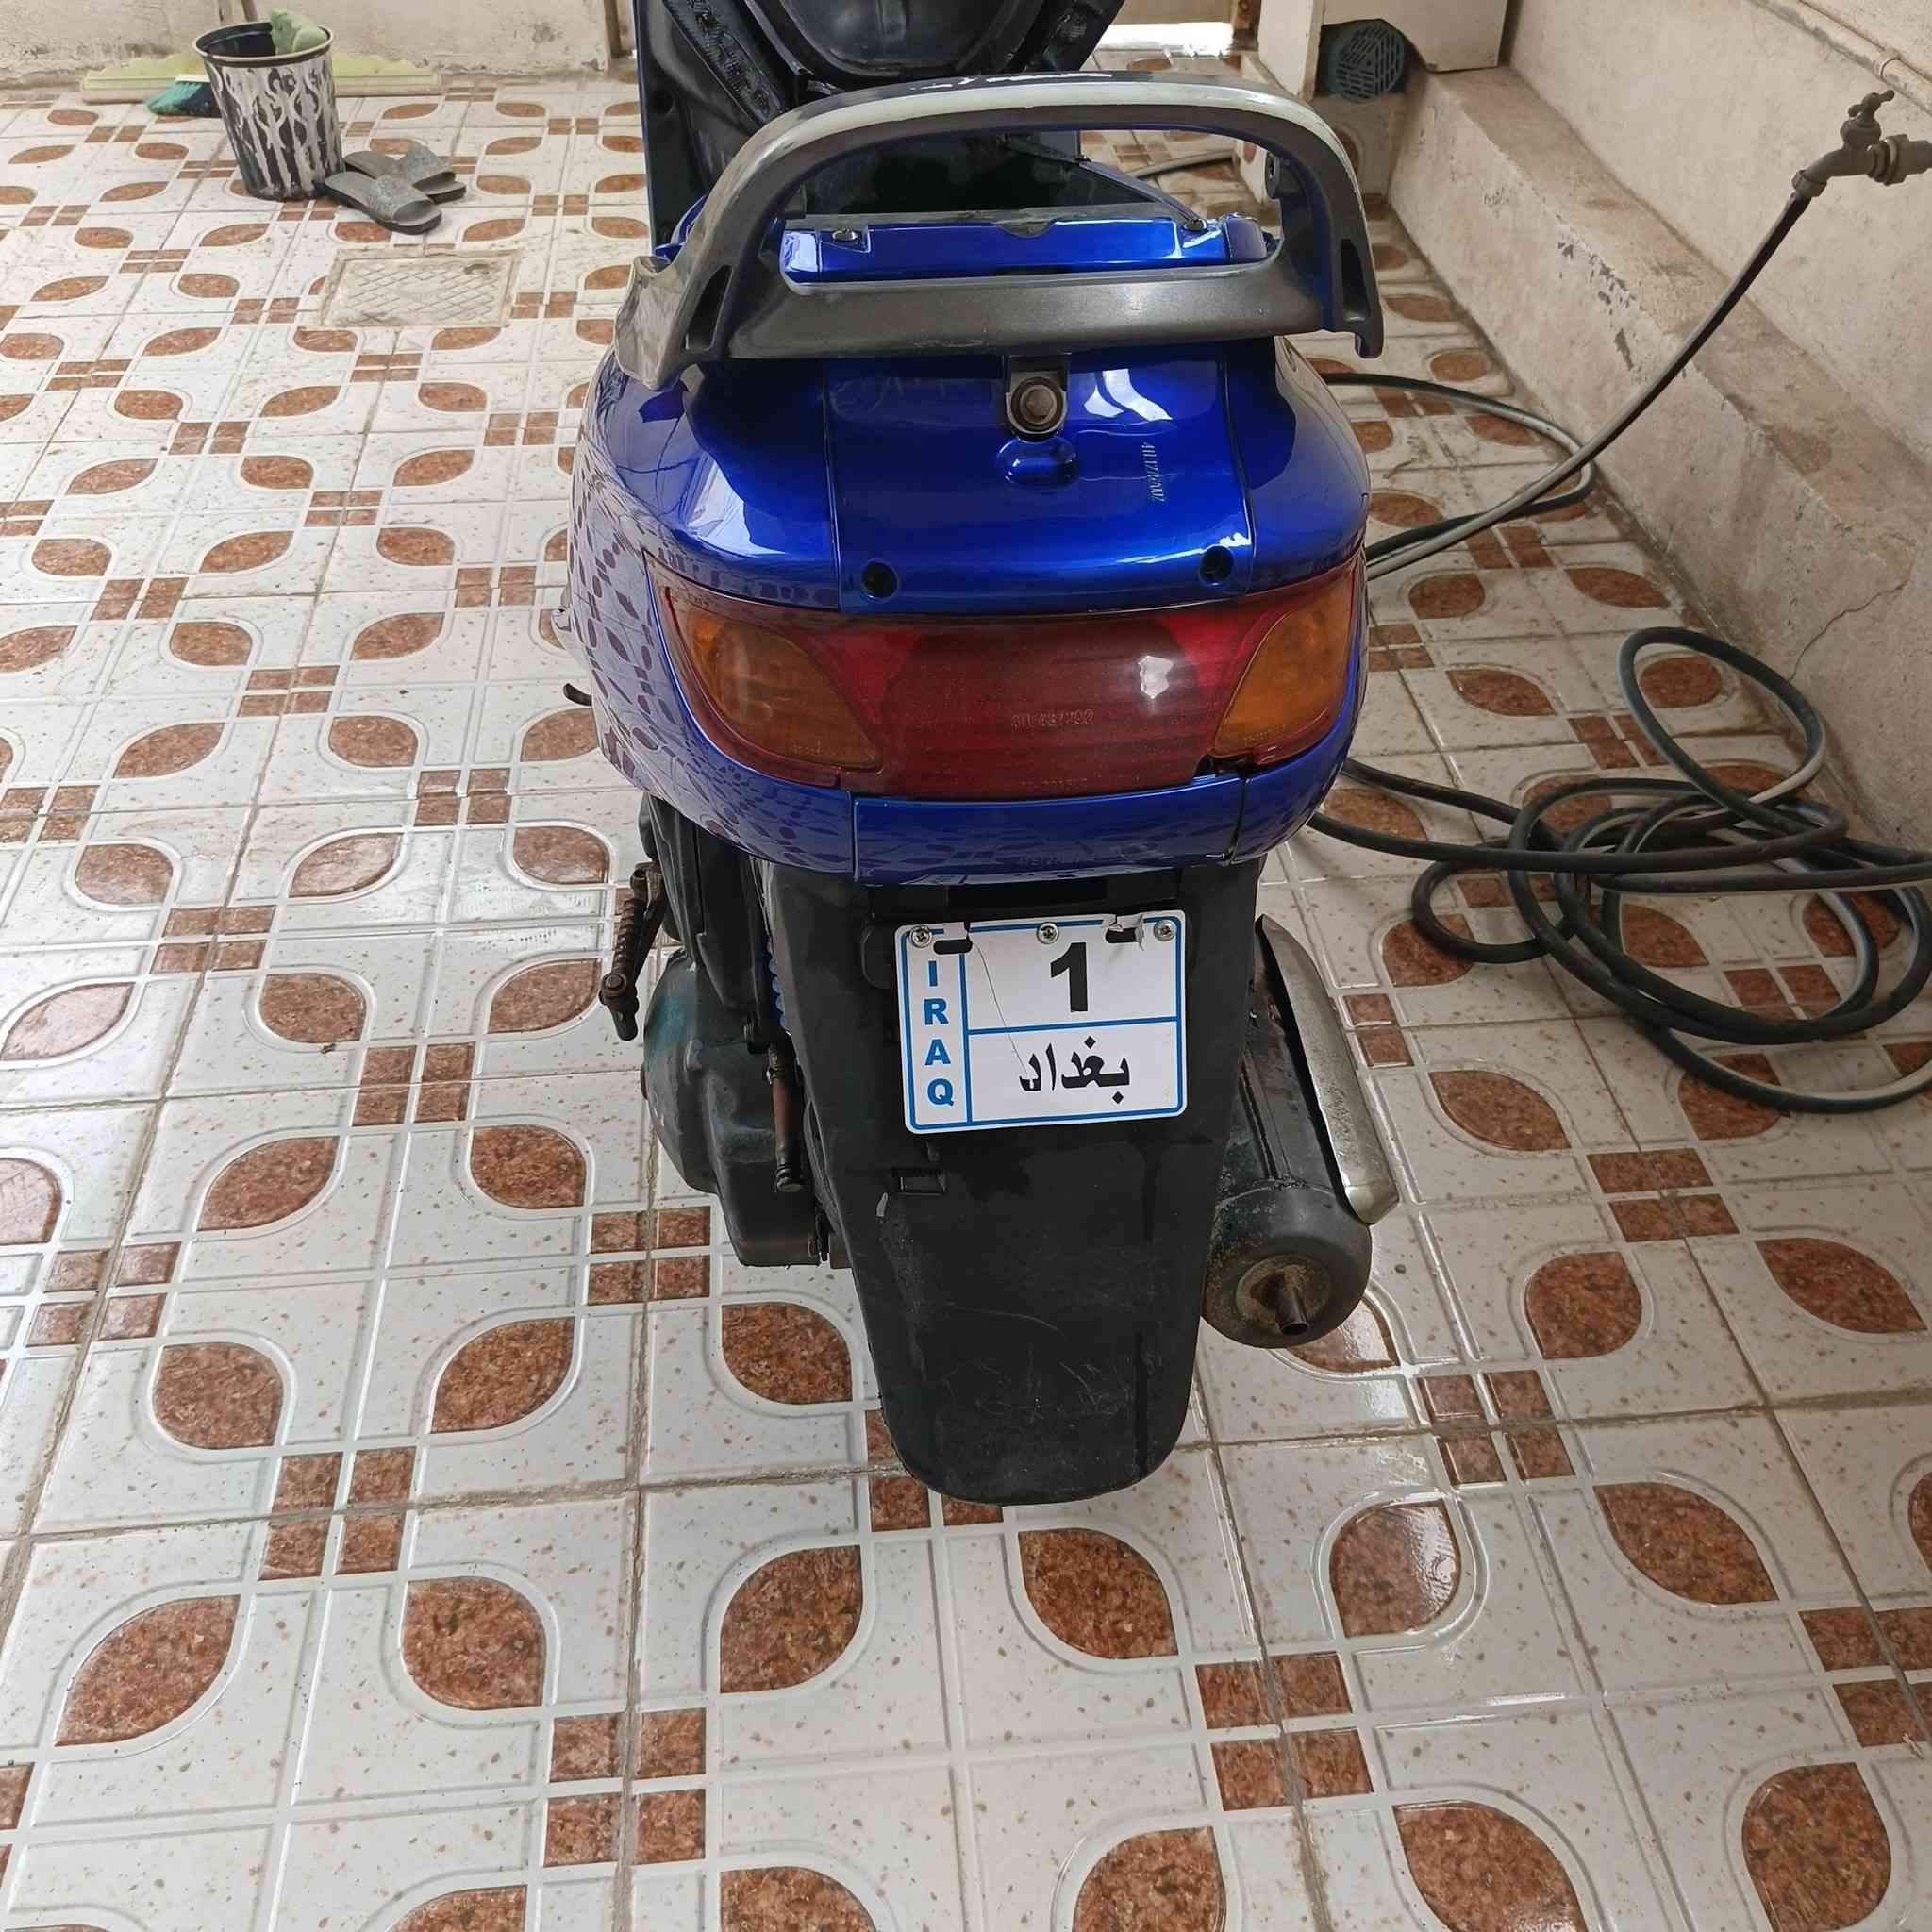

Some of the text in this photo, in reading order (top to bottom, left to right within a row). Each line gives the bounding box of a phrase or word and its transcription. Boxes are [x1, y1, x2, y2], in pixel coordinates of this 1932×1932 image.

[1050, 942, 1089, 1013] 1
[924, 960, 955, 1106] IRAQ
[1019, 1036, 1130, 1104] بغداد
